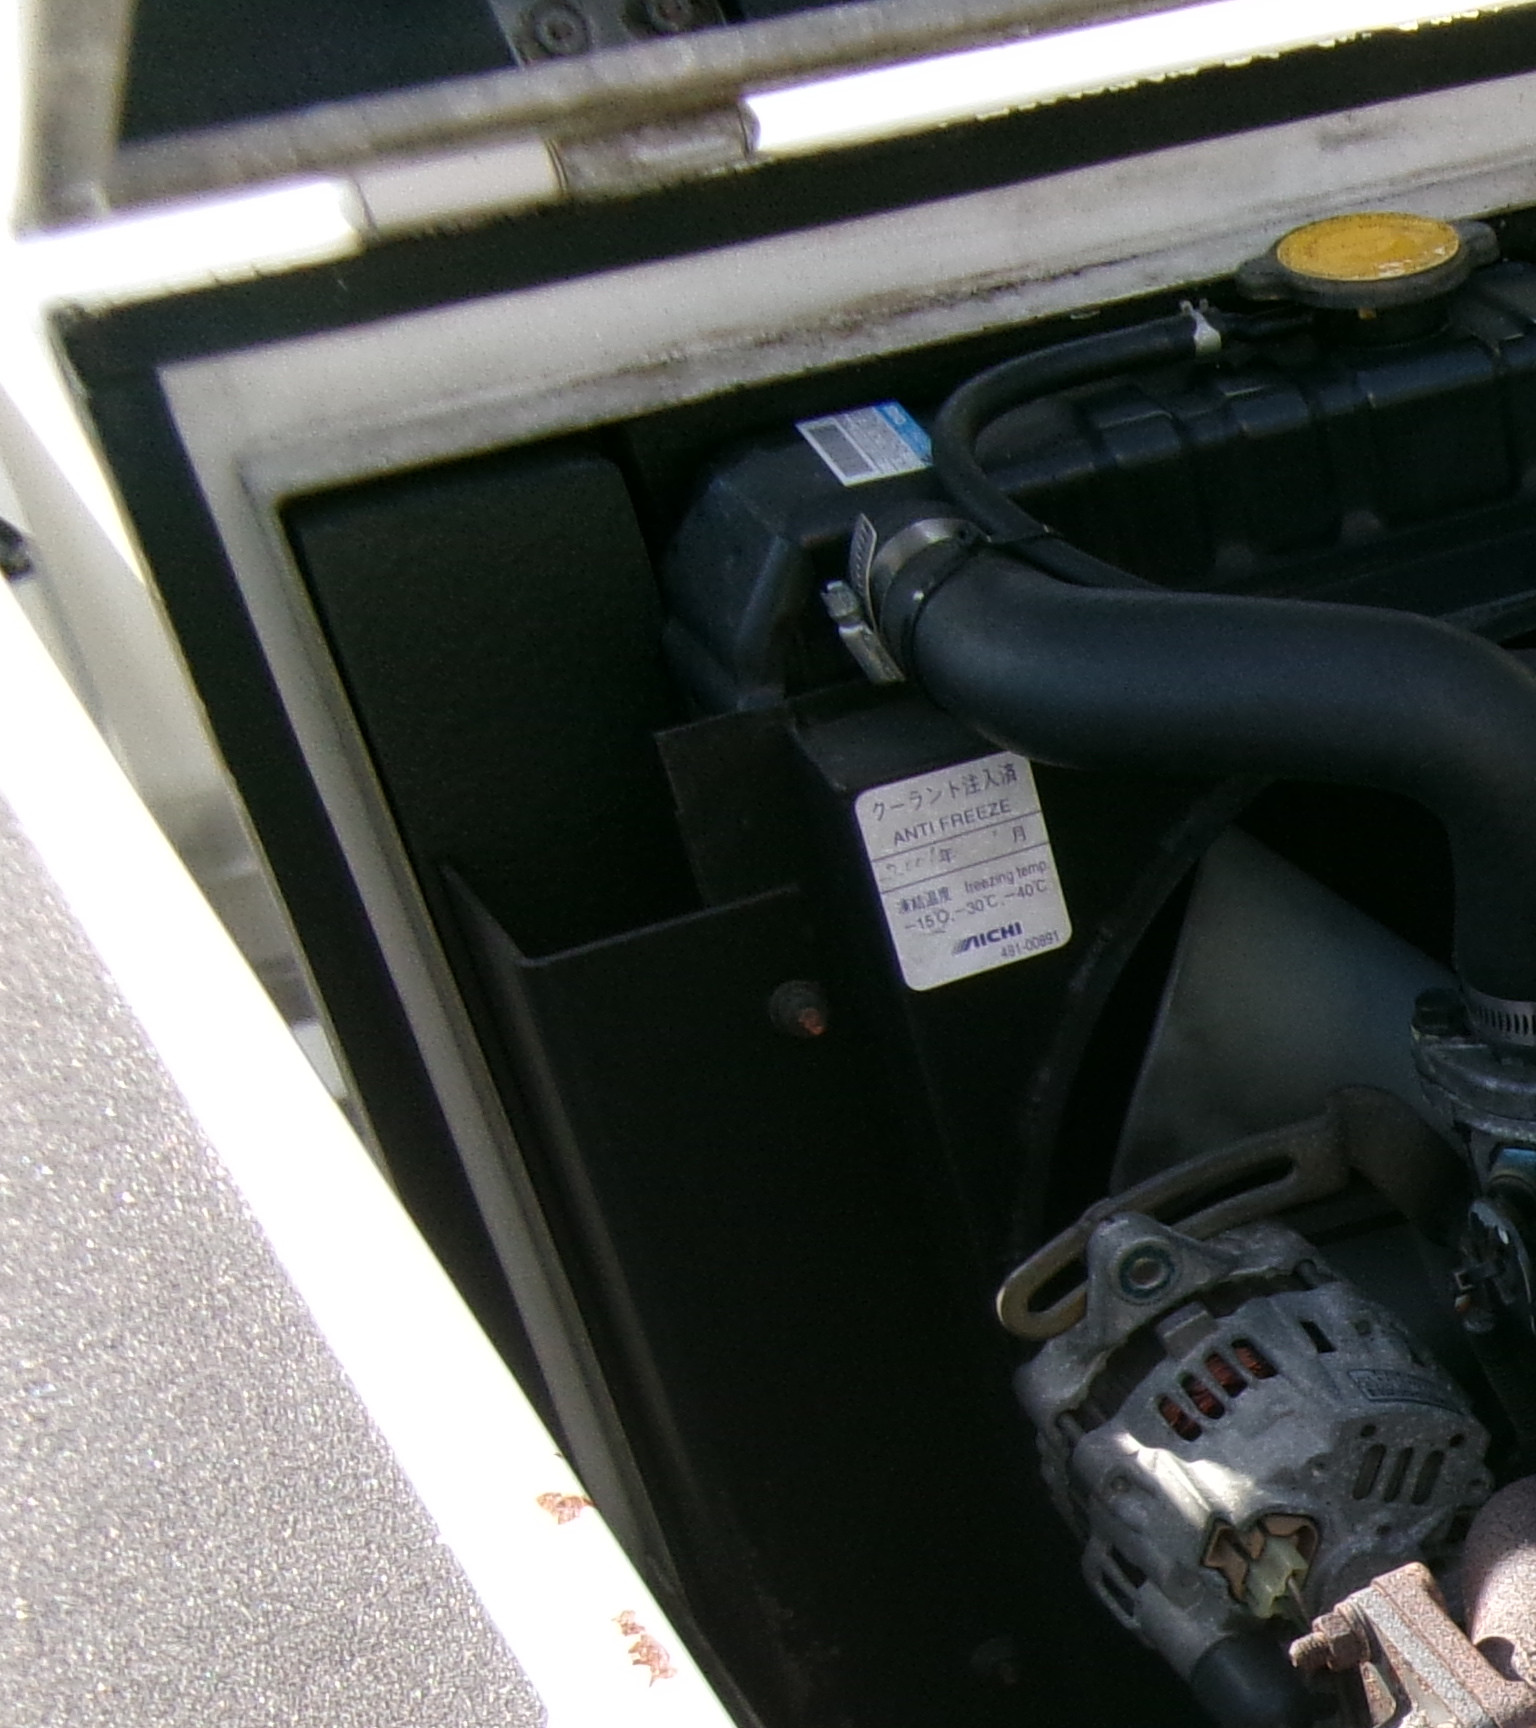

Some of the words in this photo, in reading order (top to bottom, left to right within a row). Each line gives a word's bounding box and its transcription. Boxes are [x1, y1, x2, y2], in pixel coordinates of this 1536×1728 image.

[893, 821, 935, 847] ANTI
[939, 798, 1012, 832] FREEZE
[955, 921, 1023, 954] AICHI
